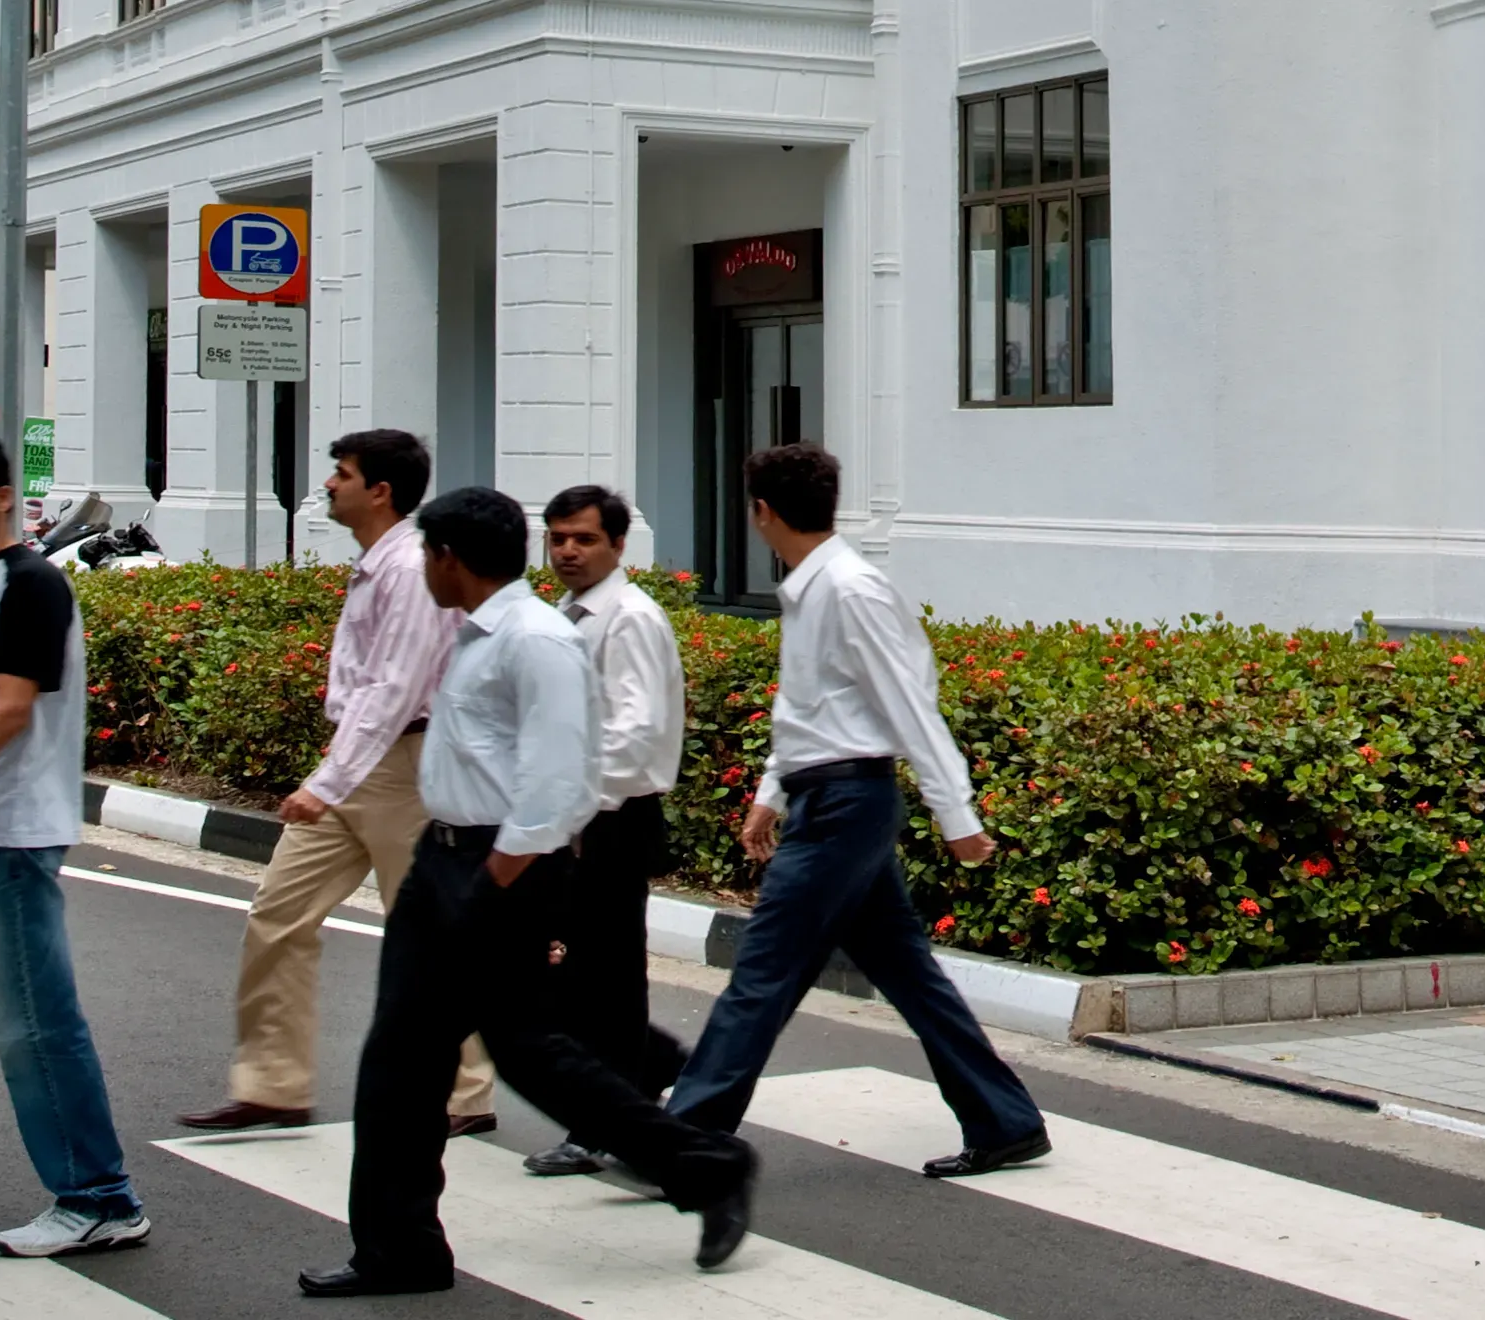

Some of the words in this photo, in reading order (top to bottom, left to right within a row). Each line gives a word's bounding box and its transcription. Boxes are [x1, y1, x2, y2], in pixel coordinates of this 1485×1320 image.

[231, 219, 288, 271] P
[216, 313, 258, 322] Motorcycle
[261, 315, 291, 324] Parking
[213, 321, 229, 330] Day
[241, 322, 262, 331] Night
[264, 323, 294, 333] Parking
